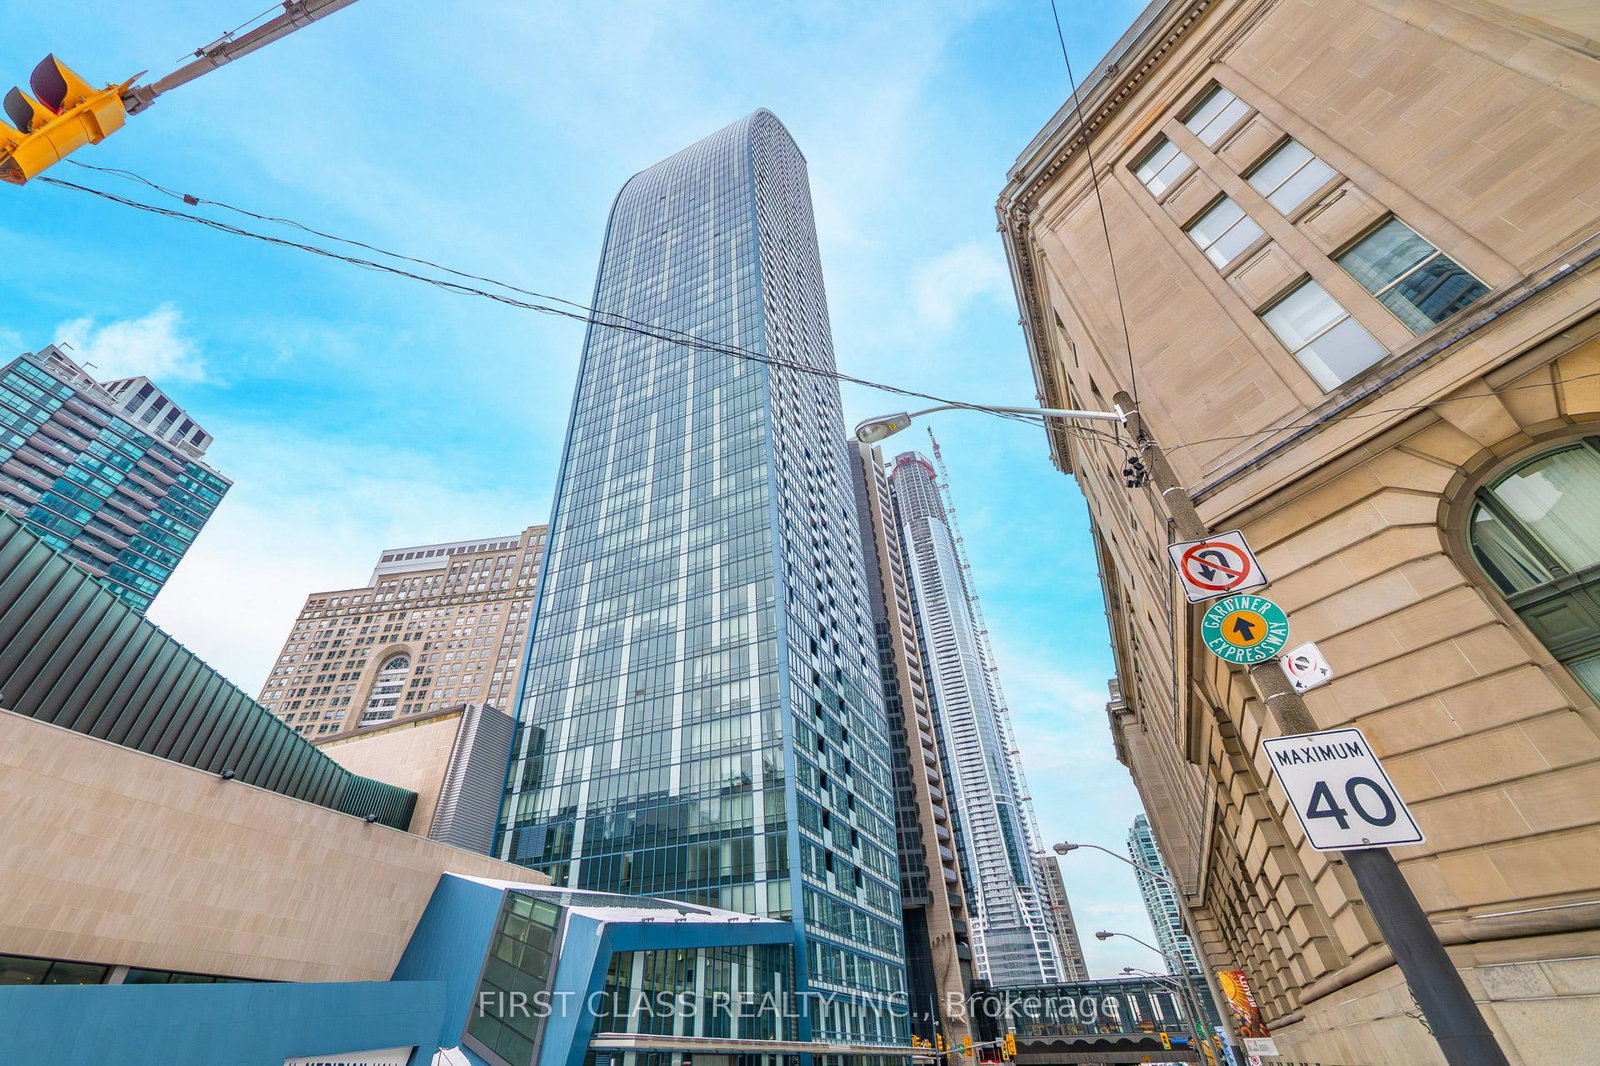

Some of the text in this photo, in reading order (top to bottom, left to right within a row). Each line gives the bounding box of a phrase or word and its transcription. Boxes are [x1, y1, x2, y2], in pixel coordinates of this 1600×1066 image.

[1204, 597, 1272, 629] GARDINER
[1208, 622, 1287, 662] EXPRESSWAY
[1275, 741, 1365, 767] MAXIMUM
[1305, 776, 1397, 830] 40
[1237, 974, 1257, 1008] BEAUTY
